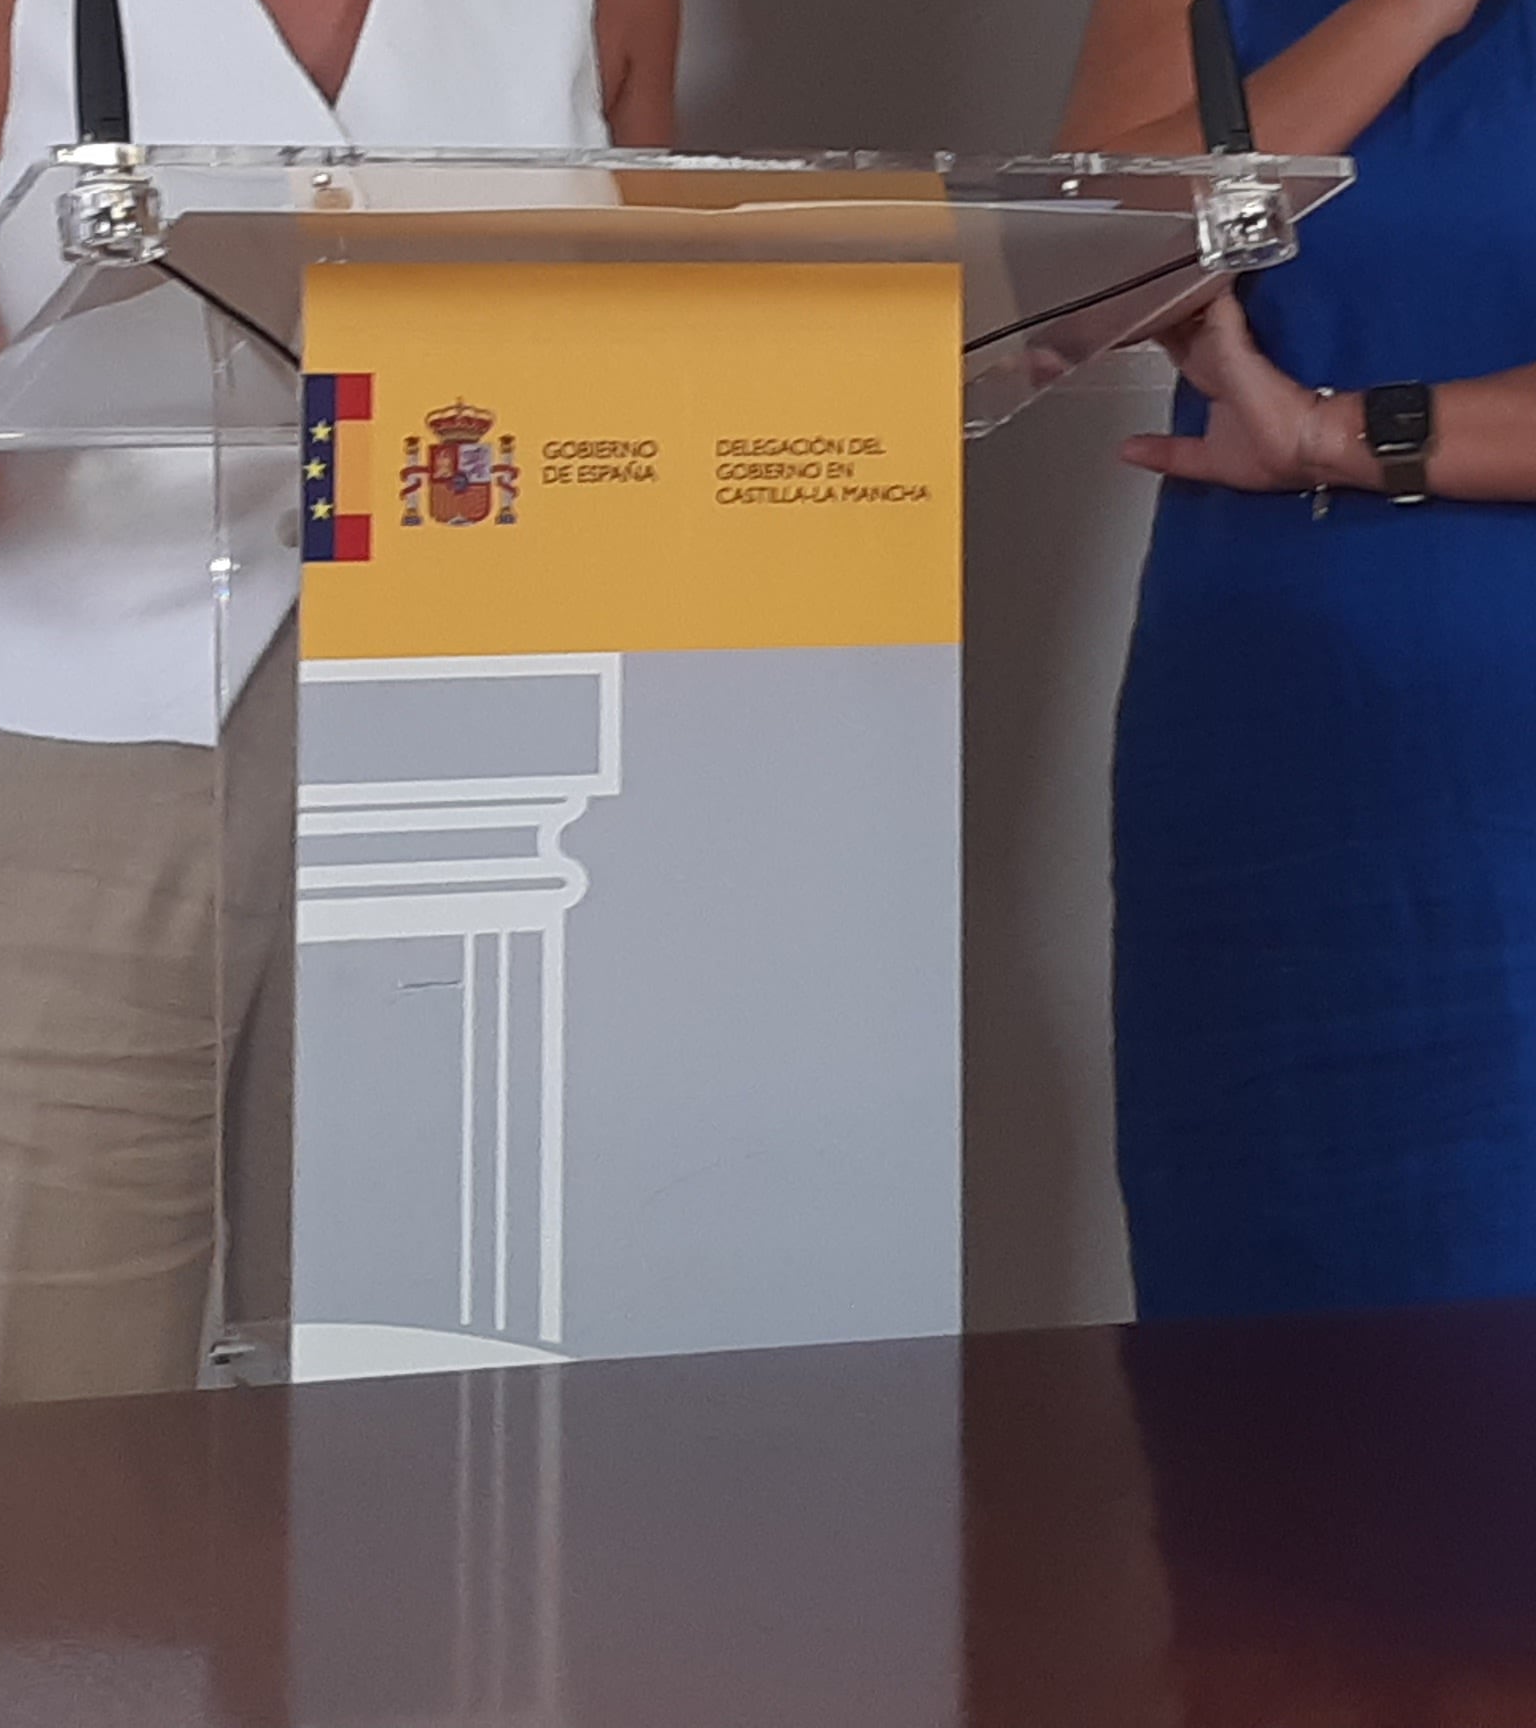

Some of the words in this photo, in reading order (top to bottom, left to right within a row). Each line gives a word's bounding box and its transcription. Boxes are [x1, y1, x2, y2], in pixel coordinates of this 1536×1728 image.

[542, 439, 658, 460] GOBIERNO
[716, 435, 845, 457] DELEGACIÓN
[848, 437, 886, 456] DEL
[542, 465, 573, 485] DE
[577, 460, 659, 483] ESPAÑA
[716, 461, 822, 480] GOBIERNO
[826, 461, 855, 479] EN
[842, 483, 931, 502] MANCHA
